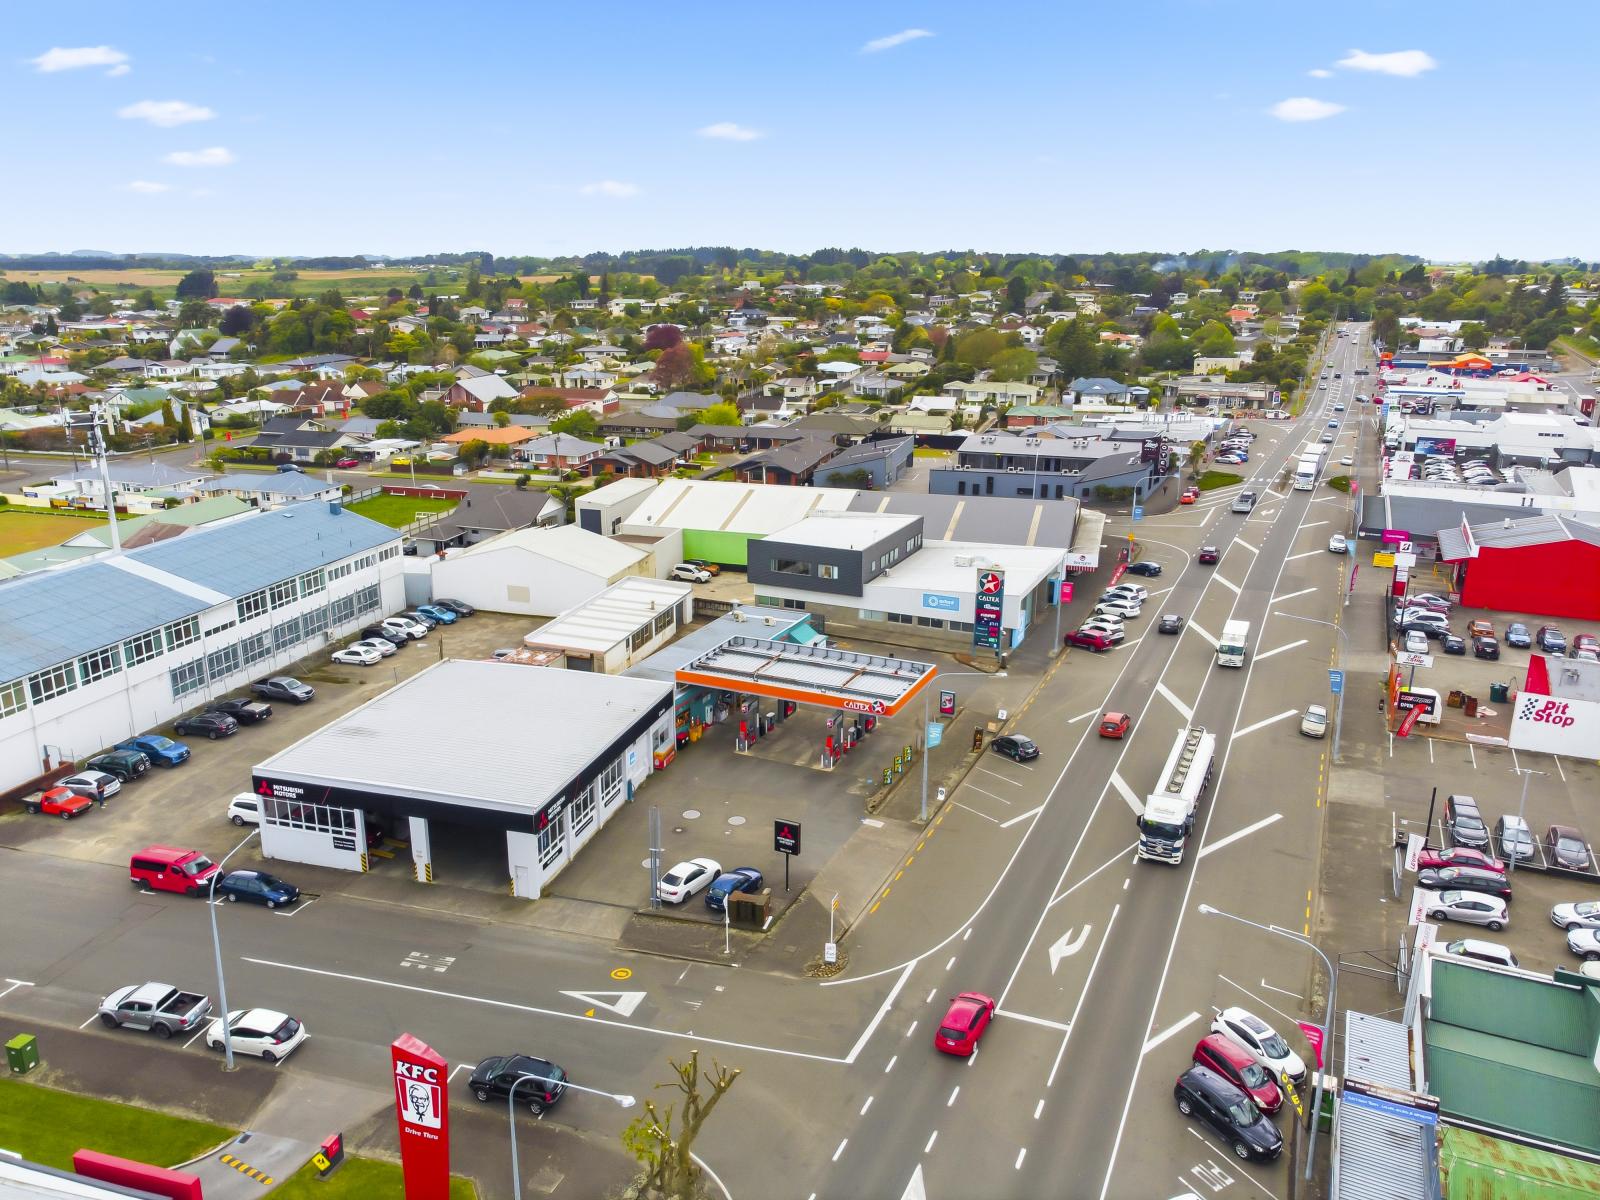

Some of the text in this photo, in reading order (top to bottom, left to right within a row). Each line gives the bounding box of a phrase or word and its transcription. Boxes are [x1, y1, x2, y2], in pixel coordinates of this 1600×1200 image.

[978, 595, 1000, 603] CALTEX
[843, 701, 870, 711] CALTEX
[1542, 700, 1569, 715] Pit
[1533, 709, 1575, 728] Stop
[273, 784, 303, 794] MITSUBISHI
[274, 790, 296, 798] MOTORS
[395, 1060, 438, 1083] KFC
[404, 1126, 439, 1140] Drive Thru
